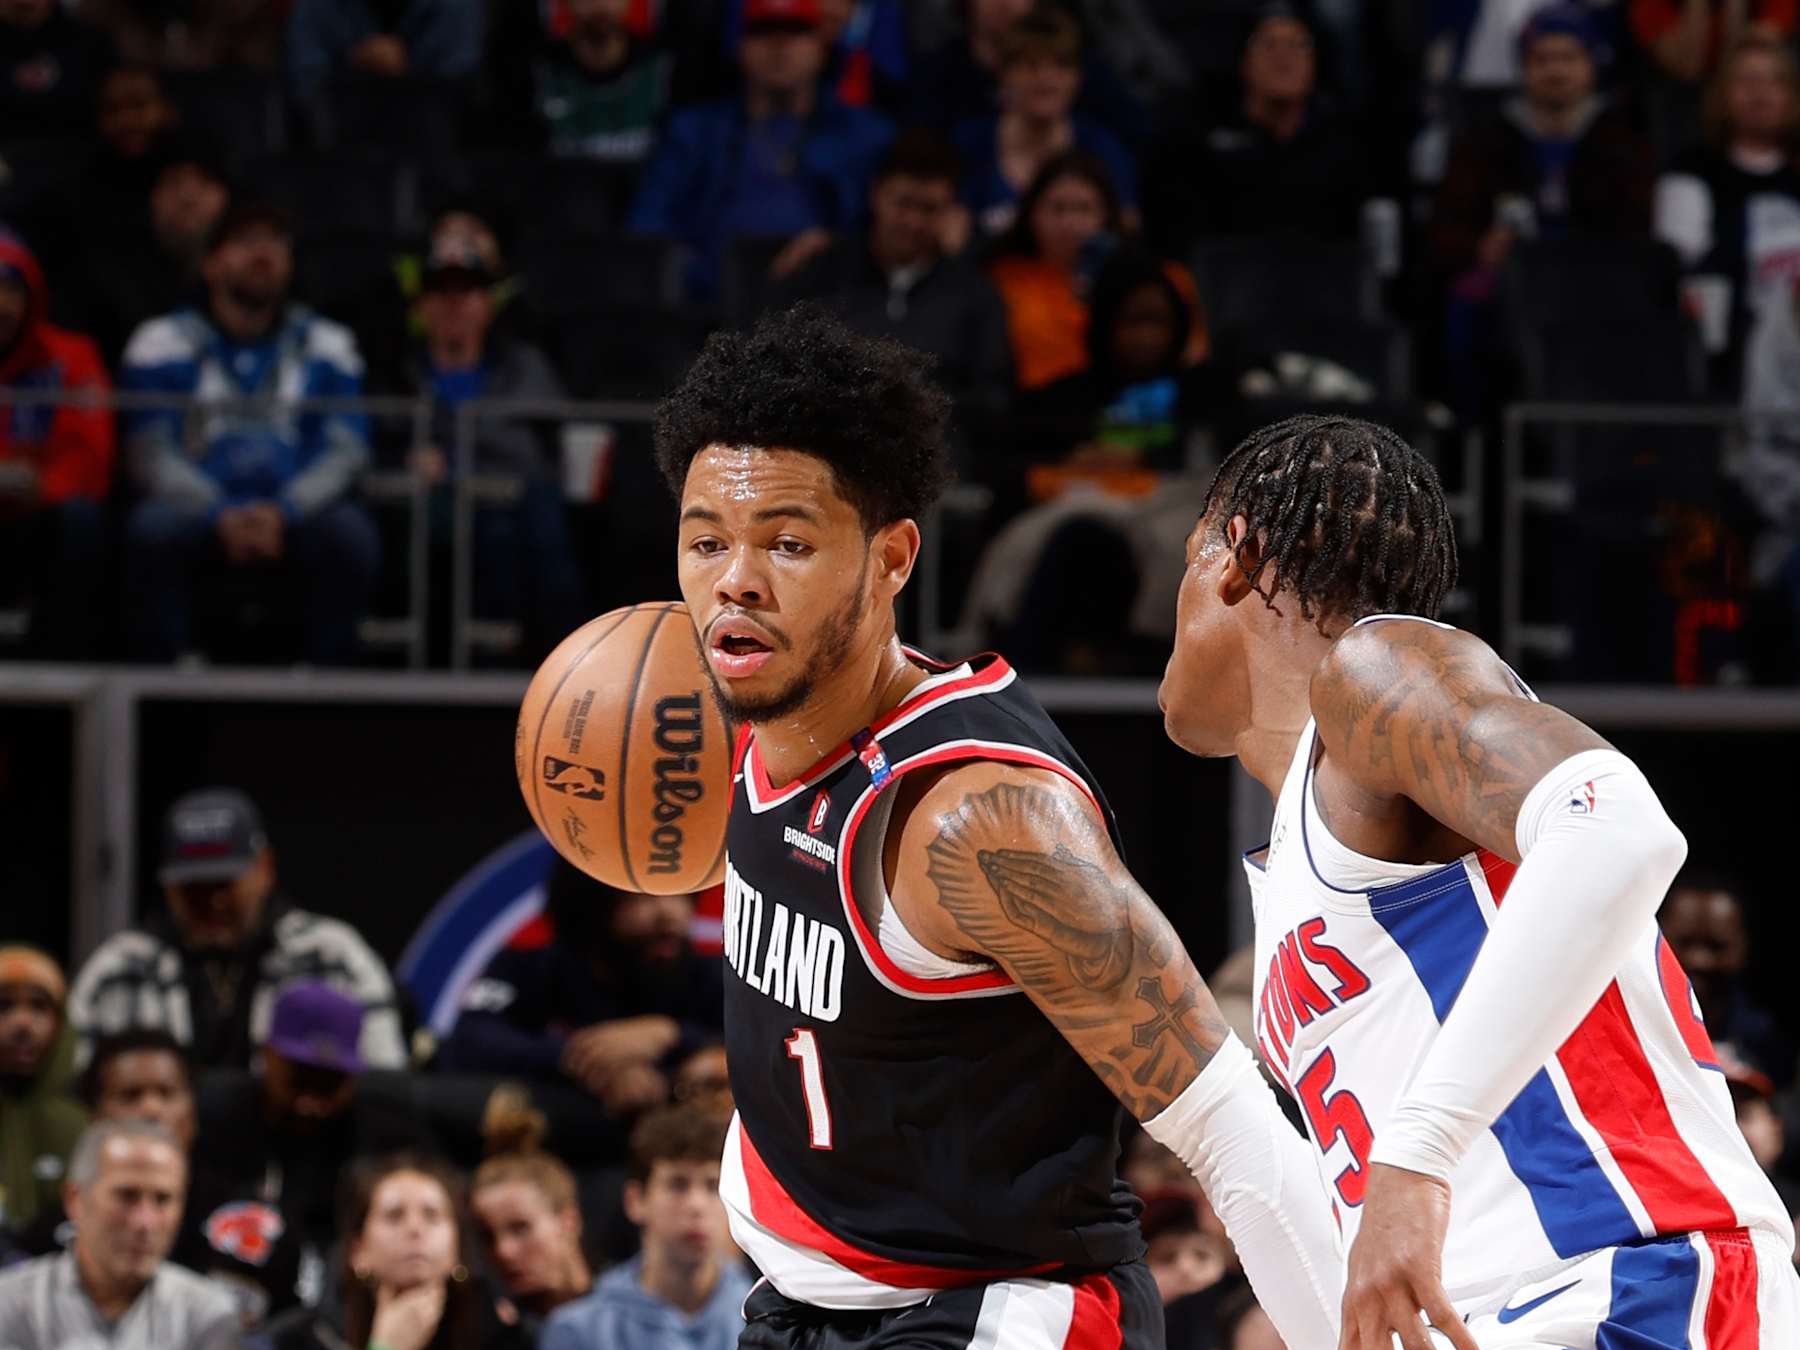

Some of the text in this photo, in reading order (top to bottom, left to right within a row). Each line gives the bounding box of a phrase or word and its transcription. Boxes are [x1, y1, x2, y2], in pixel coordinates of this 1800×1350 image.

[648, 690, 703, 874] Wilson
[784, 1027, 834, 1150] 1
[1257, 915, 1371, 1098] TONS
